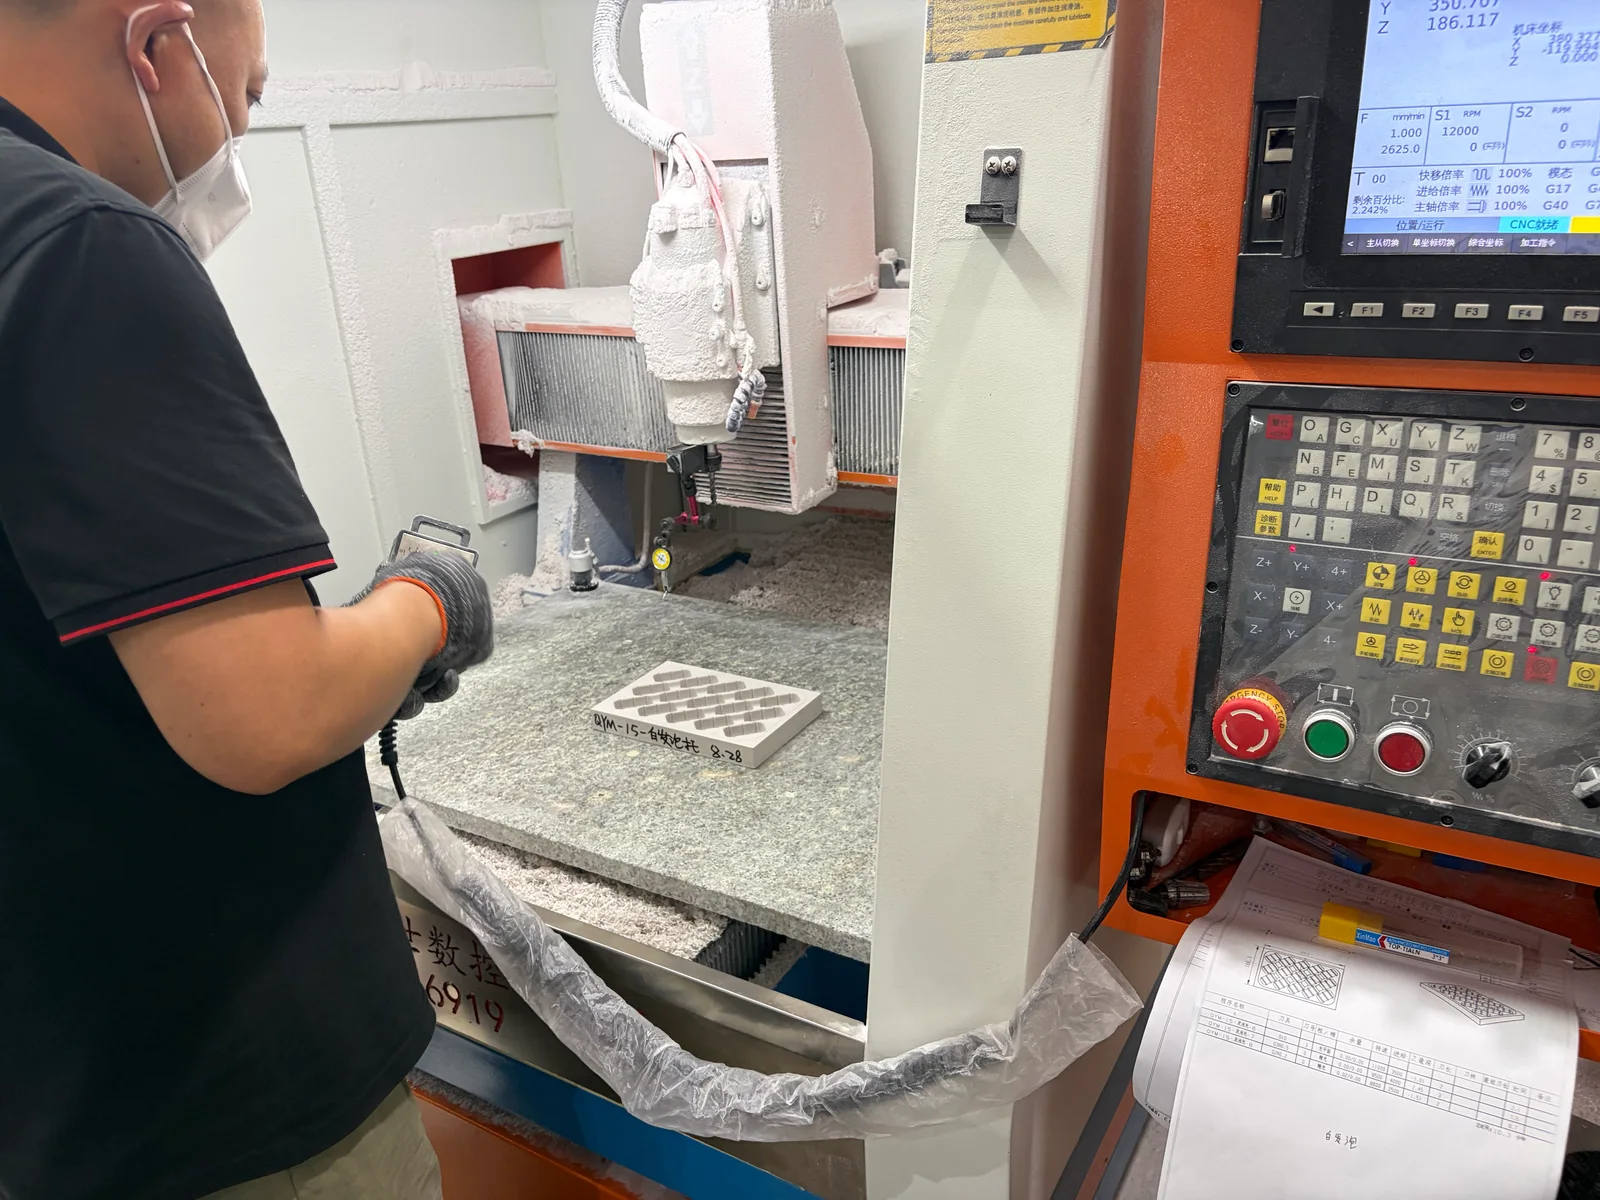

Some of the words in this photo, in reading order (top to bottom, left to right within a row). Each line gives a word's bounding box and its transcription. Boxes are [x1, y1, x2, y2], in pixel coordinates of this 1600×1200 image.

[1381, 2, 1391, 15] Y
[1377, 21, 1389, 34] Z
[1427, 12, 1499, 31] 186.117
[1508, 56, 1519, 67] Z
[1435, 109, 1451, 121] S1
[1463, 110, 1481, 118] RPM
[1515, 106, 1533, 118] S2
[1361, 113, 1368, 123] F
[1390, 128, 1422, 138] 1.000
[1442, 126, 1479, 137] 12000
[1560, 122, 1569, 133] 0
[1381, 144, 1421, 155] 2625.0
[1470, 142, 1477, 152] 0
[1558, 139, 1566, 149] 0
[1354, 171, 1366, 186] T
[1372, 174, 1386, 184] 00
[1419, 169, 1464, 181] 快移倍率
[1498, 168, 1533, 178] 100%
[1548, 167, 1573, 179] 模态
[1416, 185, 1462, 197] 进给倍率
[1496, 184, 1530, 195] 100%
[1545, 184, 1571, 194] G17
[1352, 206, 1388, 215] 2.242%
[1414, 201, 1459, 213] 主轴倍率
[1494, 201, 1527, 211] 100%
[1543, 200, 1569, 210] G40
[1396, 220, 1445, 231] 位置/运行
[1510, 219, 1559, 230] CNC就绪
[1366, 238, 1400, 248] 主从切换
[1412, 238, 1456, 248] 单坐标切换
[1520, 238, 1557, 248] 加工指令
[1362, 306, 1374, 314] F1
[1412, 307, 1425, 316] F2
[1465, 307, 1479, 316] F3
[1518, 309, 1532, 318] F4
[1574, 310, 1588, 320] F5
[1340, 422, 1352, 434] G
[1377, 423, 1389, 435] X
[1416, 425, 1427, 438] Y
[1316, 434, 1324, 442] A
[1453, 428, 1465, 440] Z
[1543, 433, 1552, 445] 7
[1352, 436, 1361, 444] C
[1428, 441, 1437, 449] V
[1583, 436, 1594, 449] 8
[1466, 443, 1478, 452] W
[1554, 448, 1564, 458] %
[1301, 452, 1311, 464] N
[1336, 454, 1346, 466] F
[1370, 457, 1384, 470] M
[1312, 466, 1320, 474] B
[1409, 460, 1421, 472] S
[1450, 462, 1460, 474] T
[1348, 469, 1355, 477] E
[1535, 470, 1546, 481] 4
[1423, 475, 1430, 483] J
[1461, 478, 1469, 486] K
[1577, 473, 1588, 485] 5
[1264, 483, 1282, 492] 帮助
[1297, 484, 1307, 496] P
[1549, 484, 1557, 494] $
[1331, 488, 1342, 499] H
[1367, 491, 1379, 502] D
[1404, 493, 1417, 506] Q
[1442, 497, 1454, 509] R
[1380, 505, 1386, 513] L
[1532, 505, 1539, 517] 1
[1570, 508, 1582, 521] 2
[1260, 515, 1277, 523] 诊断
[1456, 512, 1464, 520] &
[1259, 525, 1276, 534] 参数
[1478, 536, 1498, 546] 确认
[1524, 539, 1534, 551] 0
[1256, 557, 1272, 568] Z+
[1293, 561, 1310, 571] Y+
[1331, 565, 1347, 576] 4+
[1253, 591, 1267, 601] X-
[1325, 600, 1344, 611] X+
[1249, 624, 1263, 634] Z-
[1286, 629, 1299, 639] Y-
[1323, 635, 1336, 645] 4-
[1274, 703, 1286, 729] STOP
[710, 744, 742, 763] 8.28
[1388, 942, 1420, 956] TOP-TIALN
[426, 974, 504, 1032] 6919
